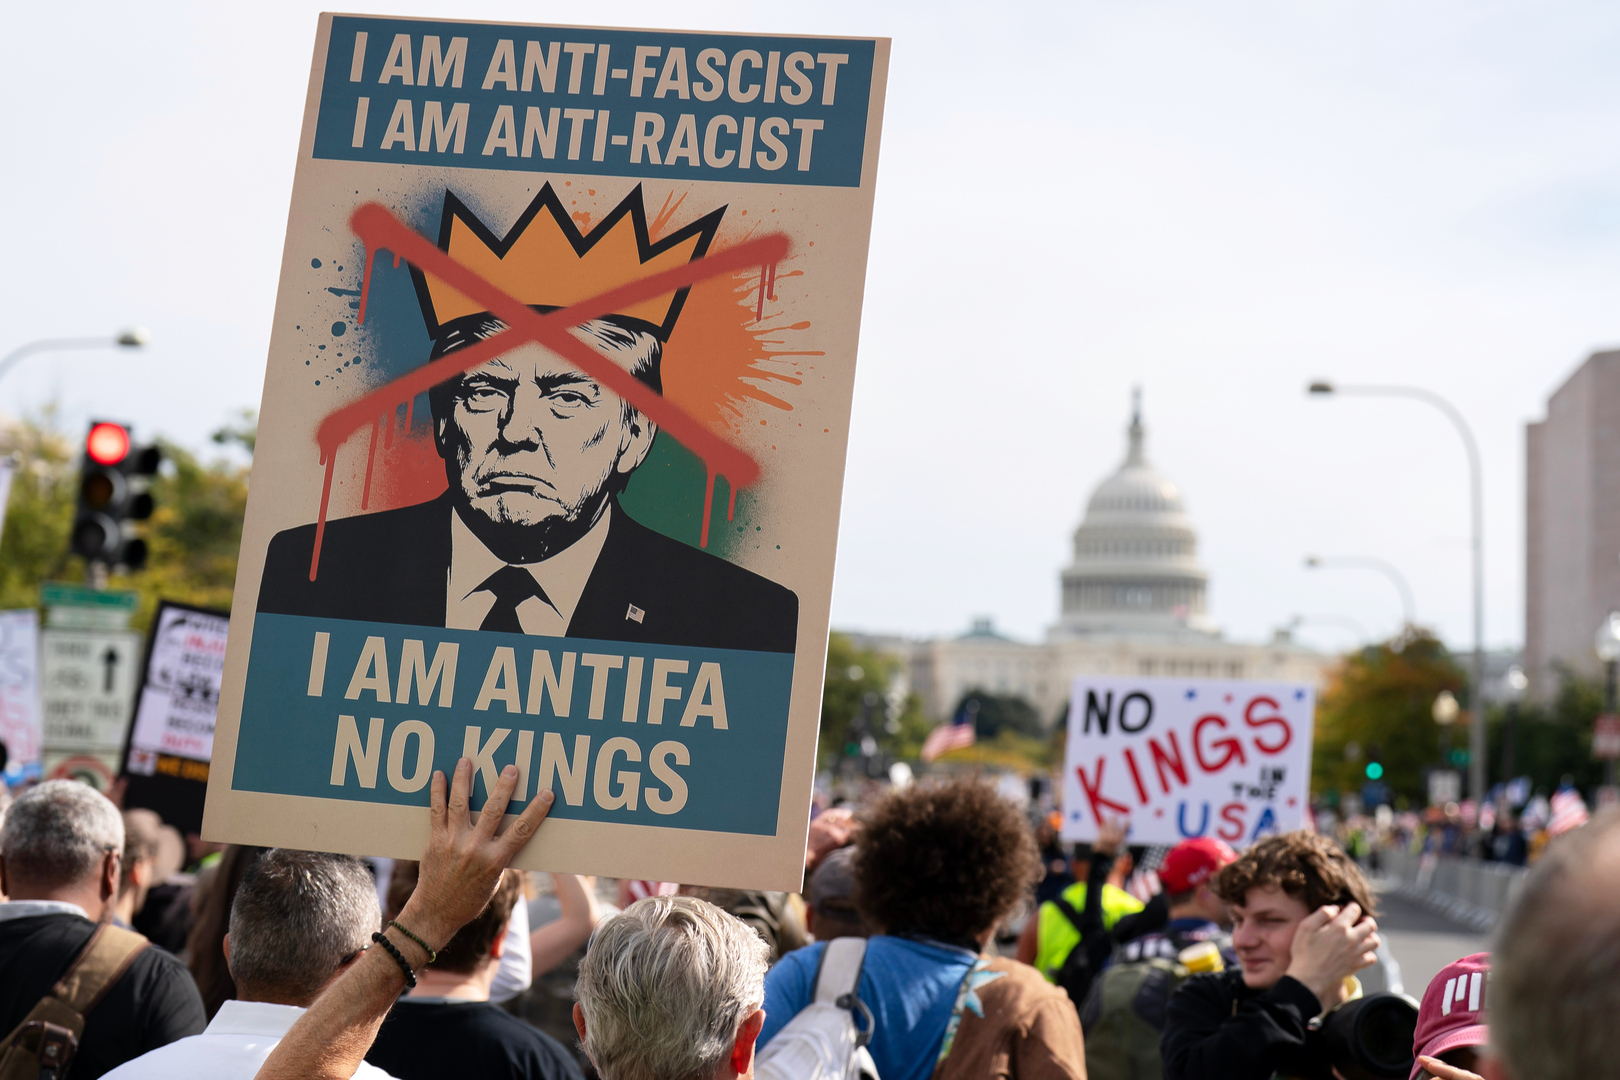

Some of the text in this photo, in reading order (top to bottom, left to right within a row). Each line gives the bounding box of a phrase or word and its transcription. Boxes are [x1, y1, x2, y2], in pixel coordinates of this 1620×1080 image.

[349, 31, 849, 106] I AM ANTI-FASCIST
[351, 97, 824, 172] I AM ANTI-RACIST
[307, 631, 729, 730] I AM ANTIFA
[1082, 689, 1154, 736] NO
[329, 714, 691, 815] NO KINGS
[1076, 695, 1293, 828] KINGS
[1231, 783, 1279, 799] THE
[1176, 801, 1278, 841] USA
